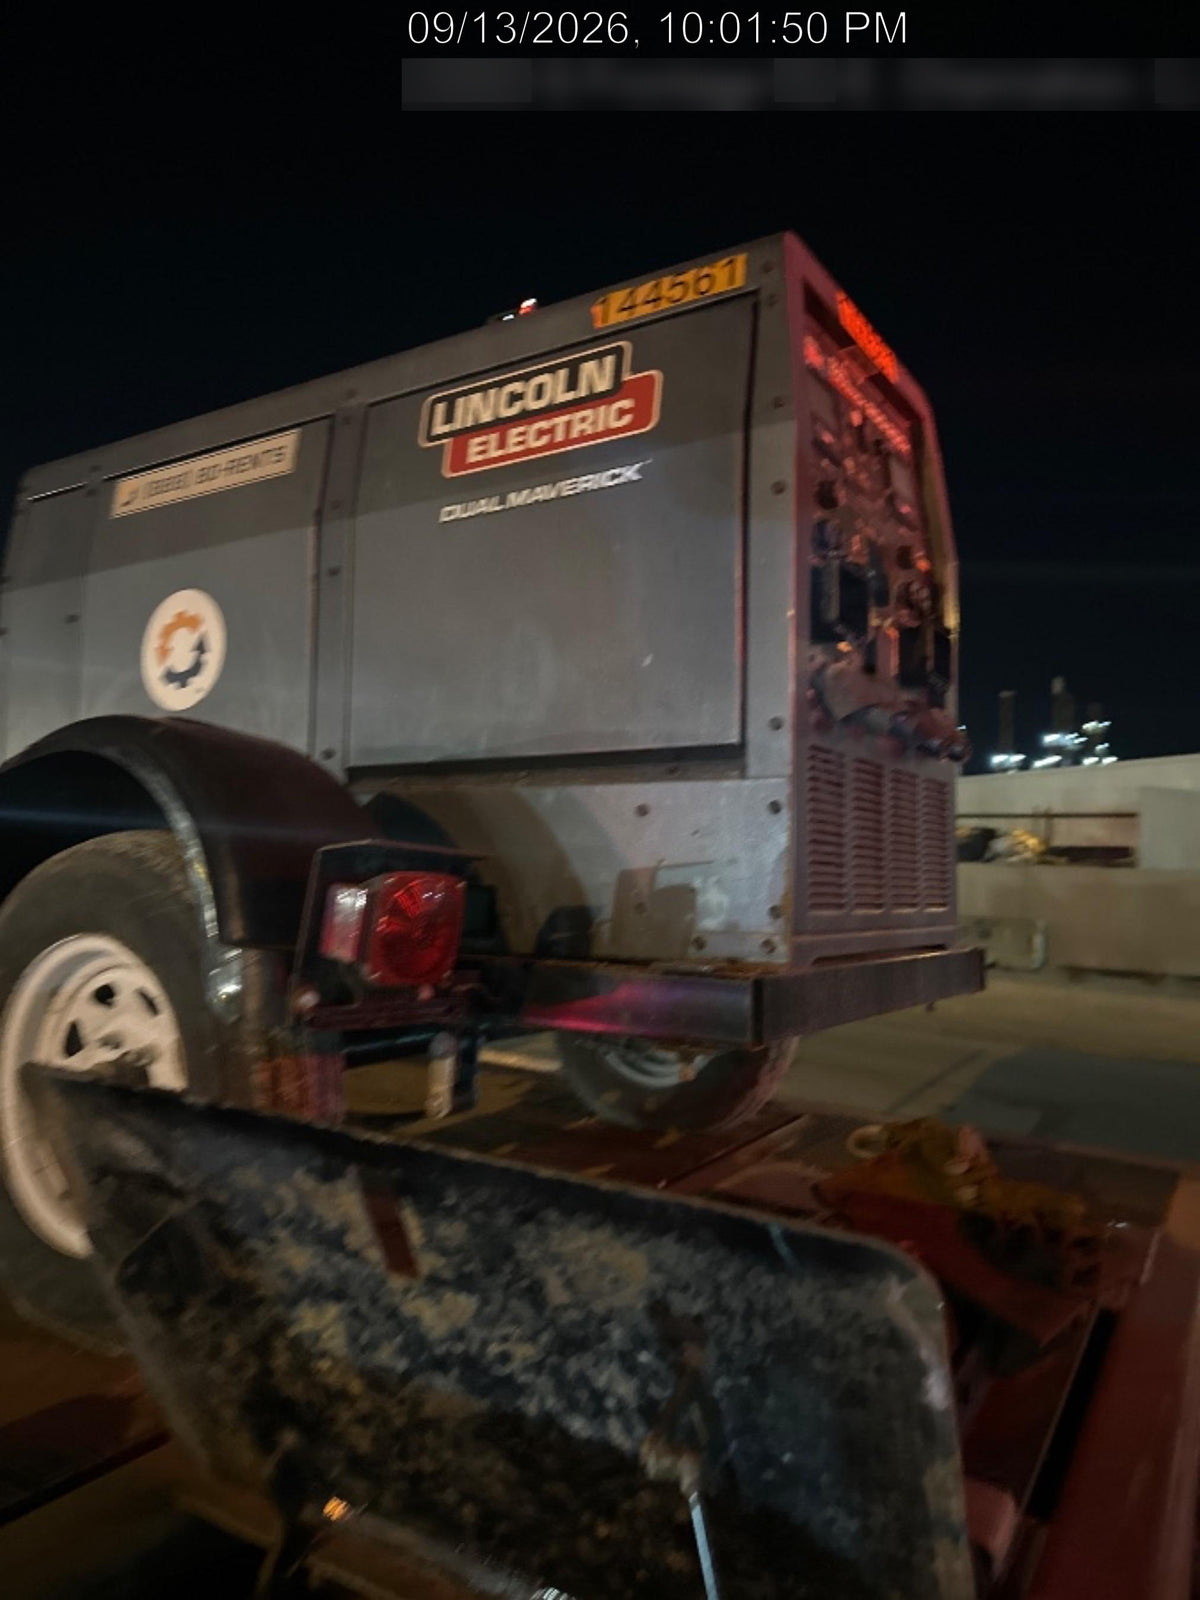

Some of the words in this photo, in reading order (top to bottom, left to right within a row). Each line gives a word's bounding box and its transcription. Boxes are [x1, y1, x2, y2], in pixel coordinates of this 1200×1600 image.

[594, 257, 736, 325] 144561
[430, 354, 616, 437] LINCOLN
[464, 398, 635, 465] ELECTRIC
